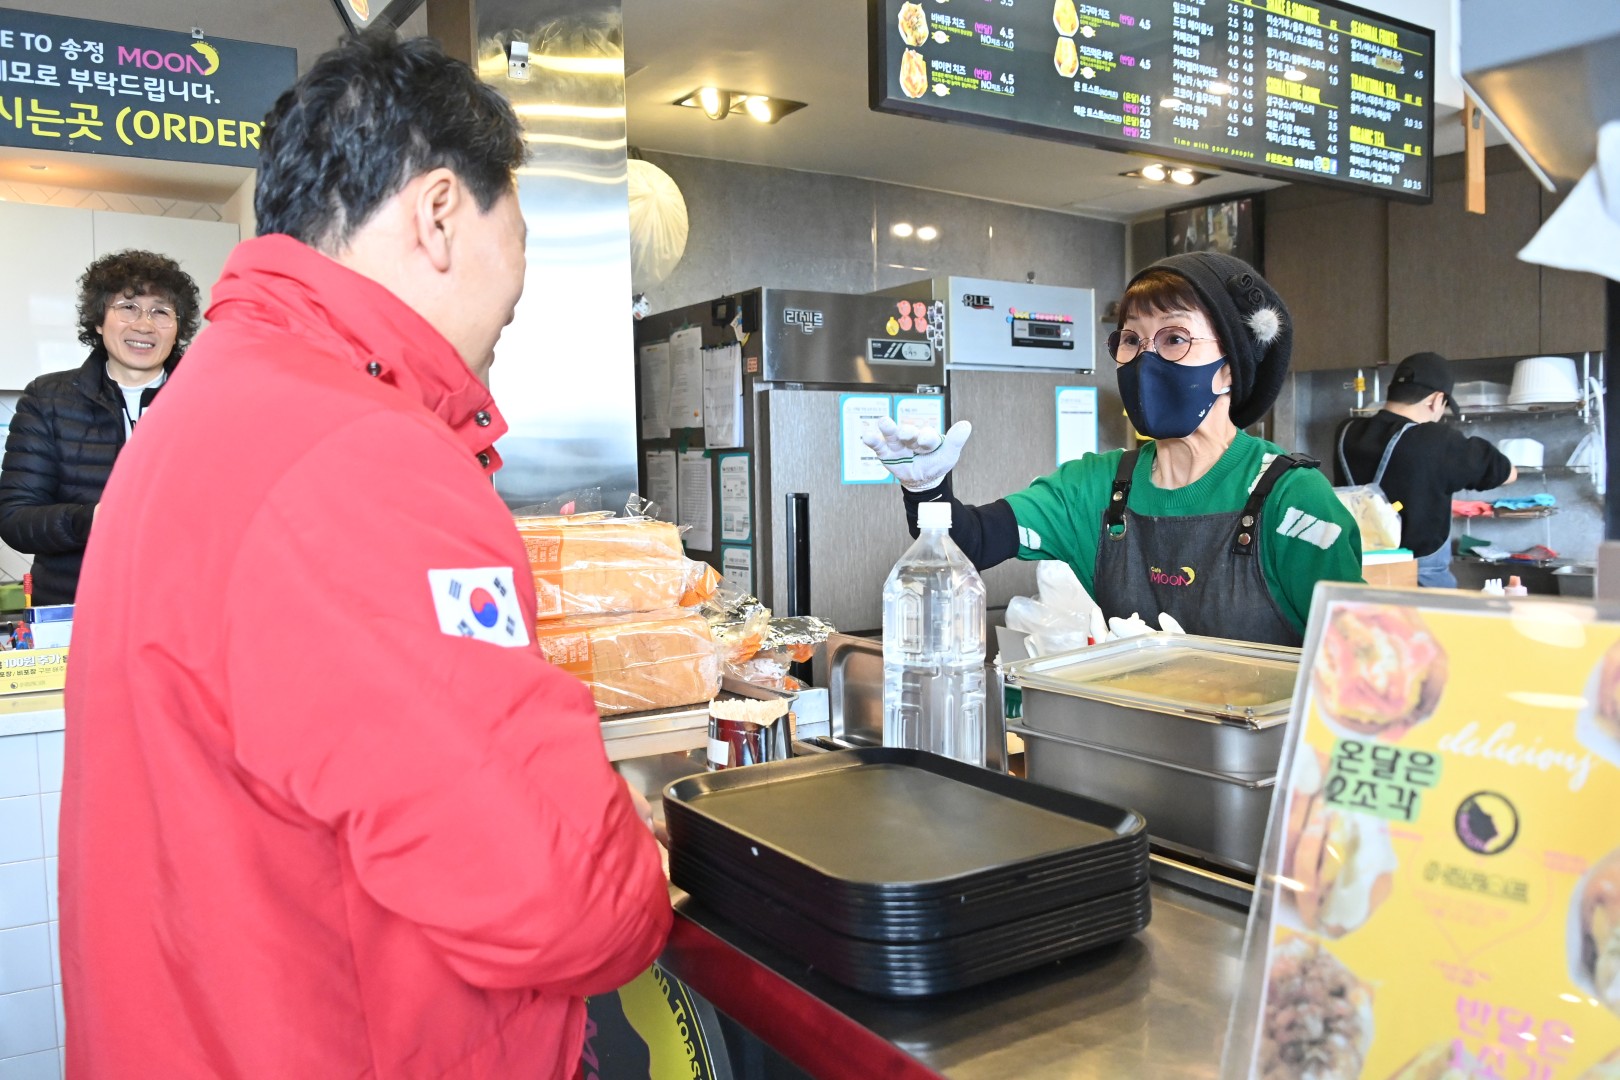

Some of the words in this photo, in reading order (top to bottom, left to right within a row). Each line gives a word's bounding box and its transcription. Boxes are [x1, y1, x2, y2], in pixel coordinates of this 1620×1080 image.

[1228, 4, 1239, 15] 2.5
[1243, 7, 1254, 19] 3.0
[931, 12, 951, 26] 바베큐
[952, 18, 966, 28] 치즈
[1000, 27, 1014, 39] 4.5
[1139, 18, 1151, 30] 4.5
[1228, 17, 1239, 28] 2.5
[1243, 21, 1254, 32] 3.0
[1228, 31, 1239, 42] 3.0
[1243, 35, 1254, 46] 3.5
[1328, 32, 1339, 43] 4.5
[20, 32, 52, 53] TO
[60, 38, 104, 64] 송정
[118, 46, 206, 76] MOON
[1228, 44, 1239, 56] 4.0
[1242, 48, 1254, 59] 4.5
[1328, 44, 1339, 55] 4.5
[1139, 58, 1151, 70] 4.5
[1228, 58, 1239, 69] 4.5
[1242, 62, 1254, 73] 4.8
[1328, 64, 1339, 75] 4.5
[932, 60, 952, 73] 베이컨
[953, 65, 966, 75] 치즈
[1000, 73, 1014, 85] 4.5
[1228, 72, 1239, 83] 4.5
[1242, 75, 1254, 86] 4.8
[1414, 70, 1424, 80] 4.5
[68, 68, 220, 104] 부탁드립니다.
[1328, 76, 1338, 86] 1.0
[1140, 94, 1151, 106] 4.5
[1242, 89, 1254, 100] 4.5
[1140, 106, 1151, 117] 2.3
[1228, 99, 1239, 110] 4.0
[1242, 103, 1254, 113] 4.5
[1227, 113, 1239, 124] 4.5
[1242, 116, 1254, 127] 4.8
[1328, 110, 1338, 121] 3.5
[116, 106, 266, 150] (ORDER
[1140, 118, 1151, 129] 5.0
[1328, 121, 1338, 131] 3.5
[1140, 129, 1151, 140] 2.5
[1227, 126, 1239, 137] 2.5
[1327, 133, 1338, 144] 4.5
[1173, 137, 1190, 148] Time
[1193, 140, 1209, 150] with
[1212, 144, 1229, 155] good
[1327, 145, 1338, 155] 4.5
[785, 310, 823, 333] 라셀르
[1151, 572, 1188, 586] MOON
[6, 656, 36, 668] 100원
[38, 654, 61, 666] 추가
[1336, 740, 1434, 786] 온달은
[673, 998, 702, 1080] Toas
